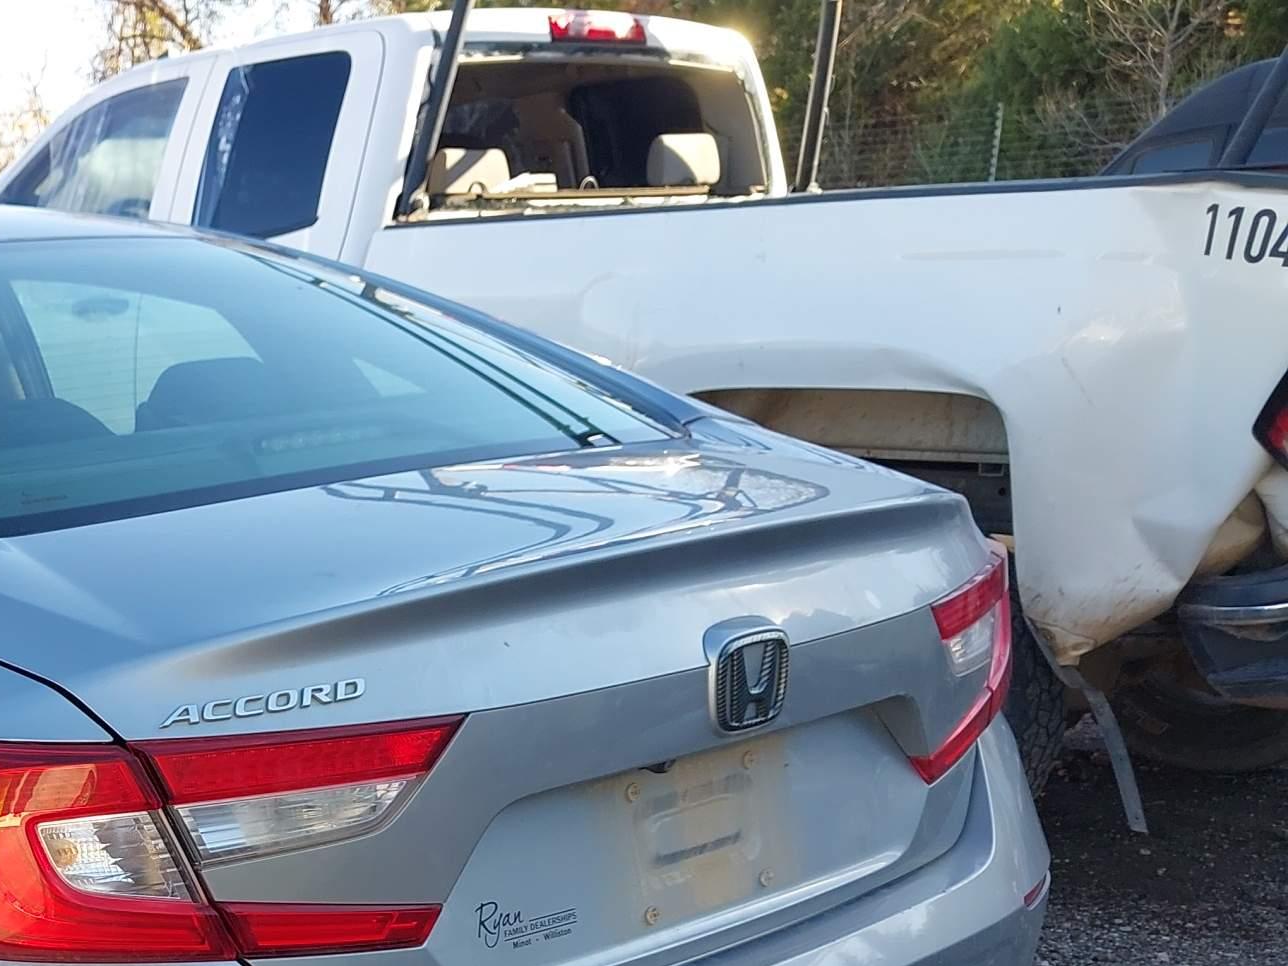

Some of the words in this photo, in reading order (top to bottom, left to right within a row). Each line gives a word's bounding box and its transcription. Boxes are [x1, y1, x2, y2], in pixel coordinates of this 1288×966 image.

[159, 677, 366, 729] ACCORD
[474, 901, 524, 949] Ryan
[503, 924, 529, 938] FAMILY
[530, 911, 577, 931] DEALERSHIPS
[512, 938, 532, 949] Minot
[543, 928, 573, 941] Williston
